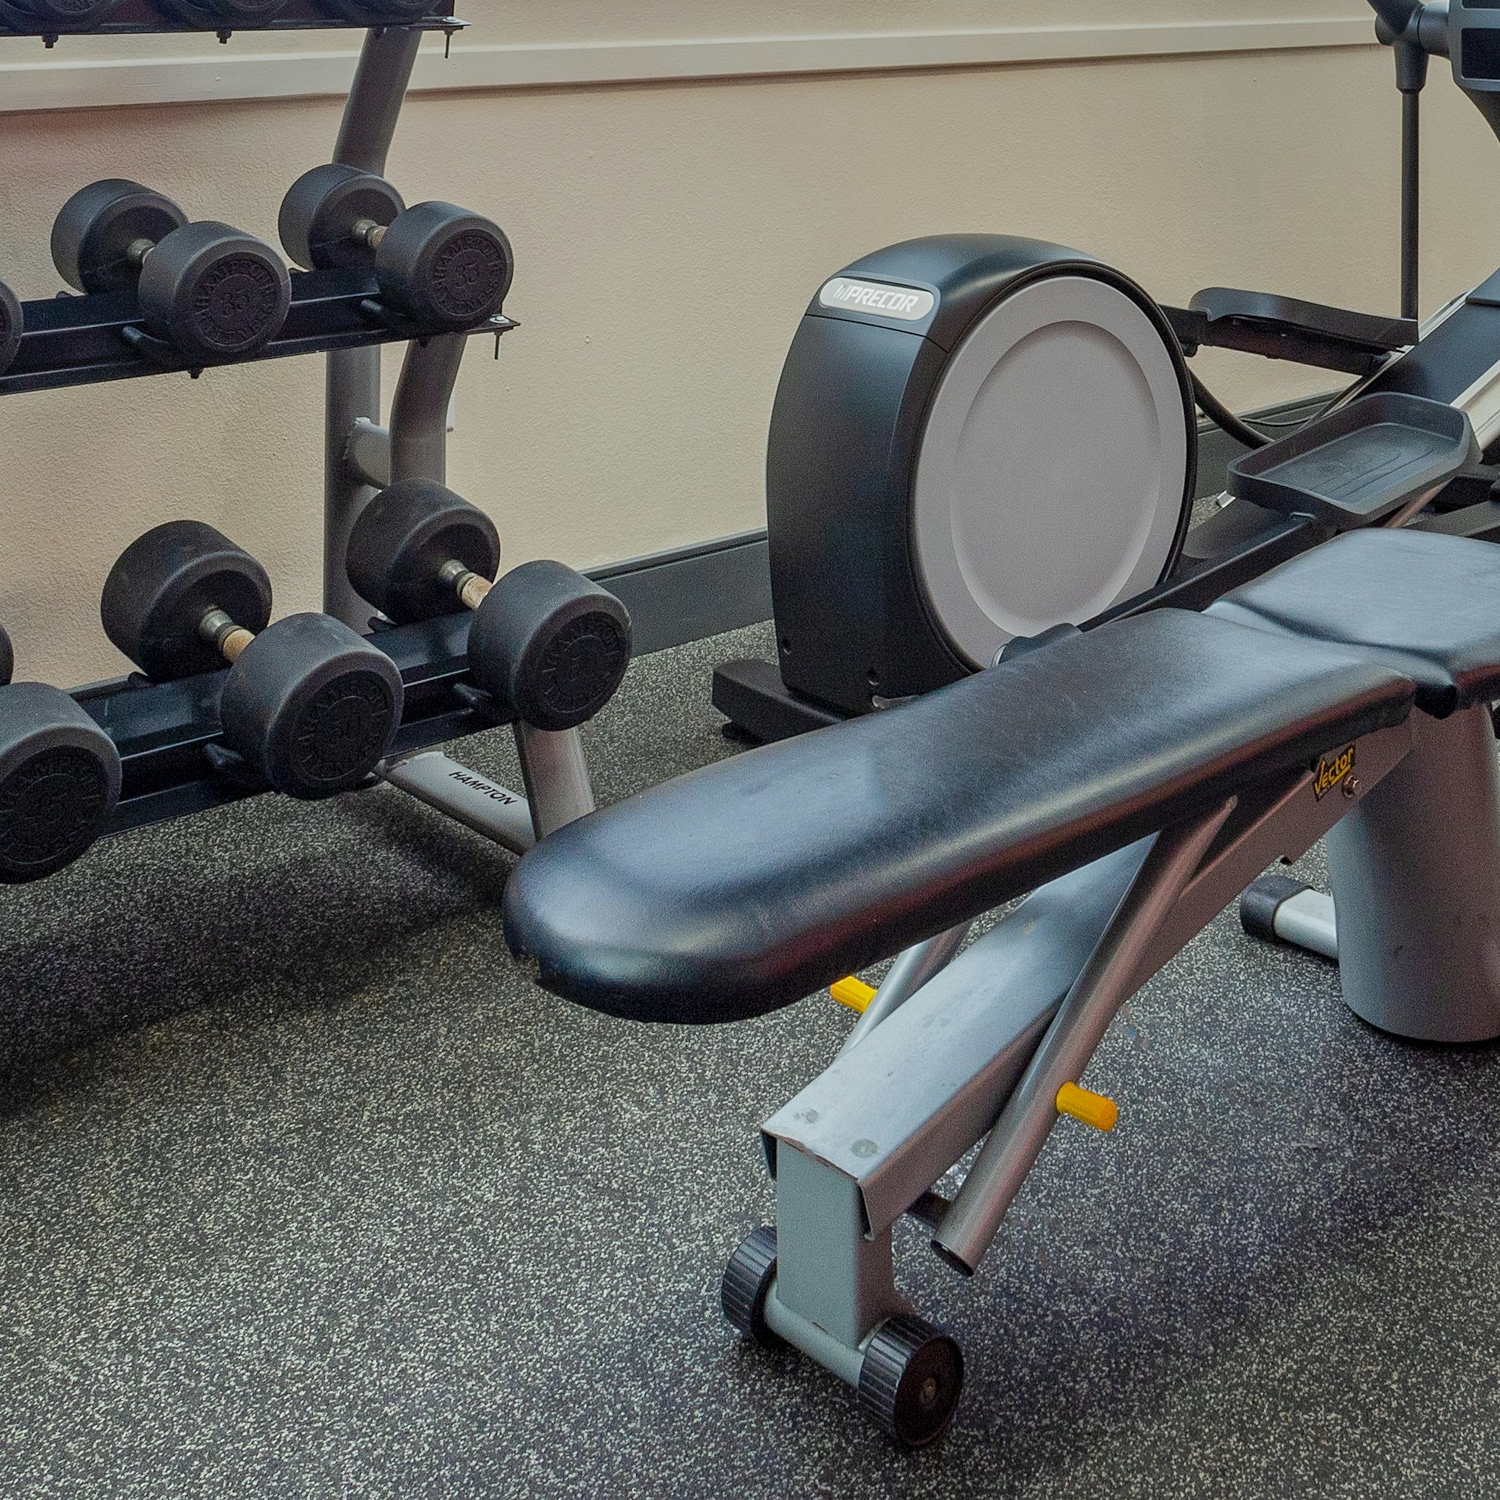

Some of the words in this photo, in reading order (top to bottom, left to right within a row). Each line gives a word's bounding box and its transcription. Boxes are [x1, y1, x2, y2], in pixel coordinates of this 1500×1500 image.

[453, 262, 480, 290] 35
[222, 288, 249, 318] 35
[844, 285, 919, 312] PRECOR
[449, 771, 517, 805] HAMPTON
